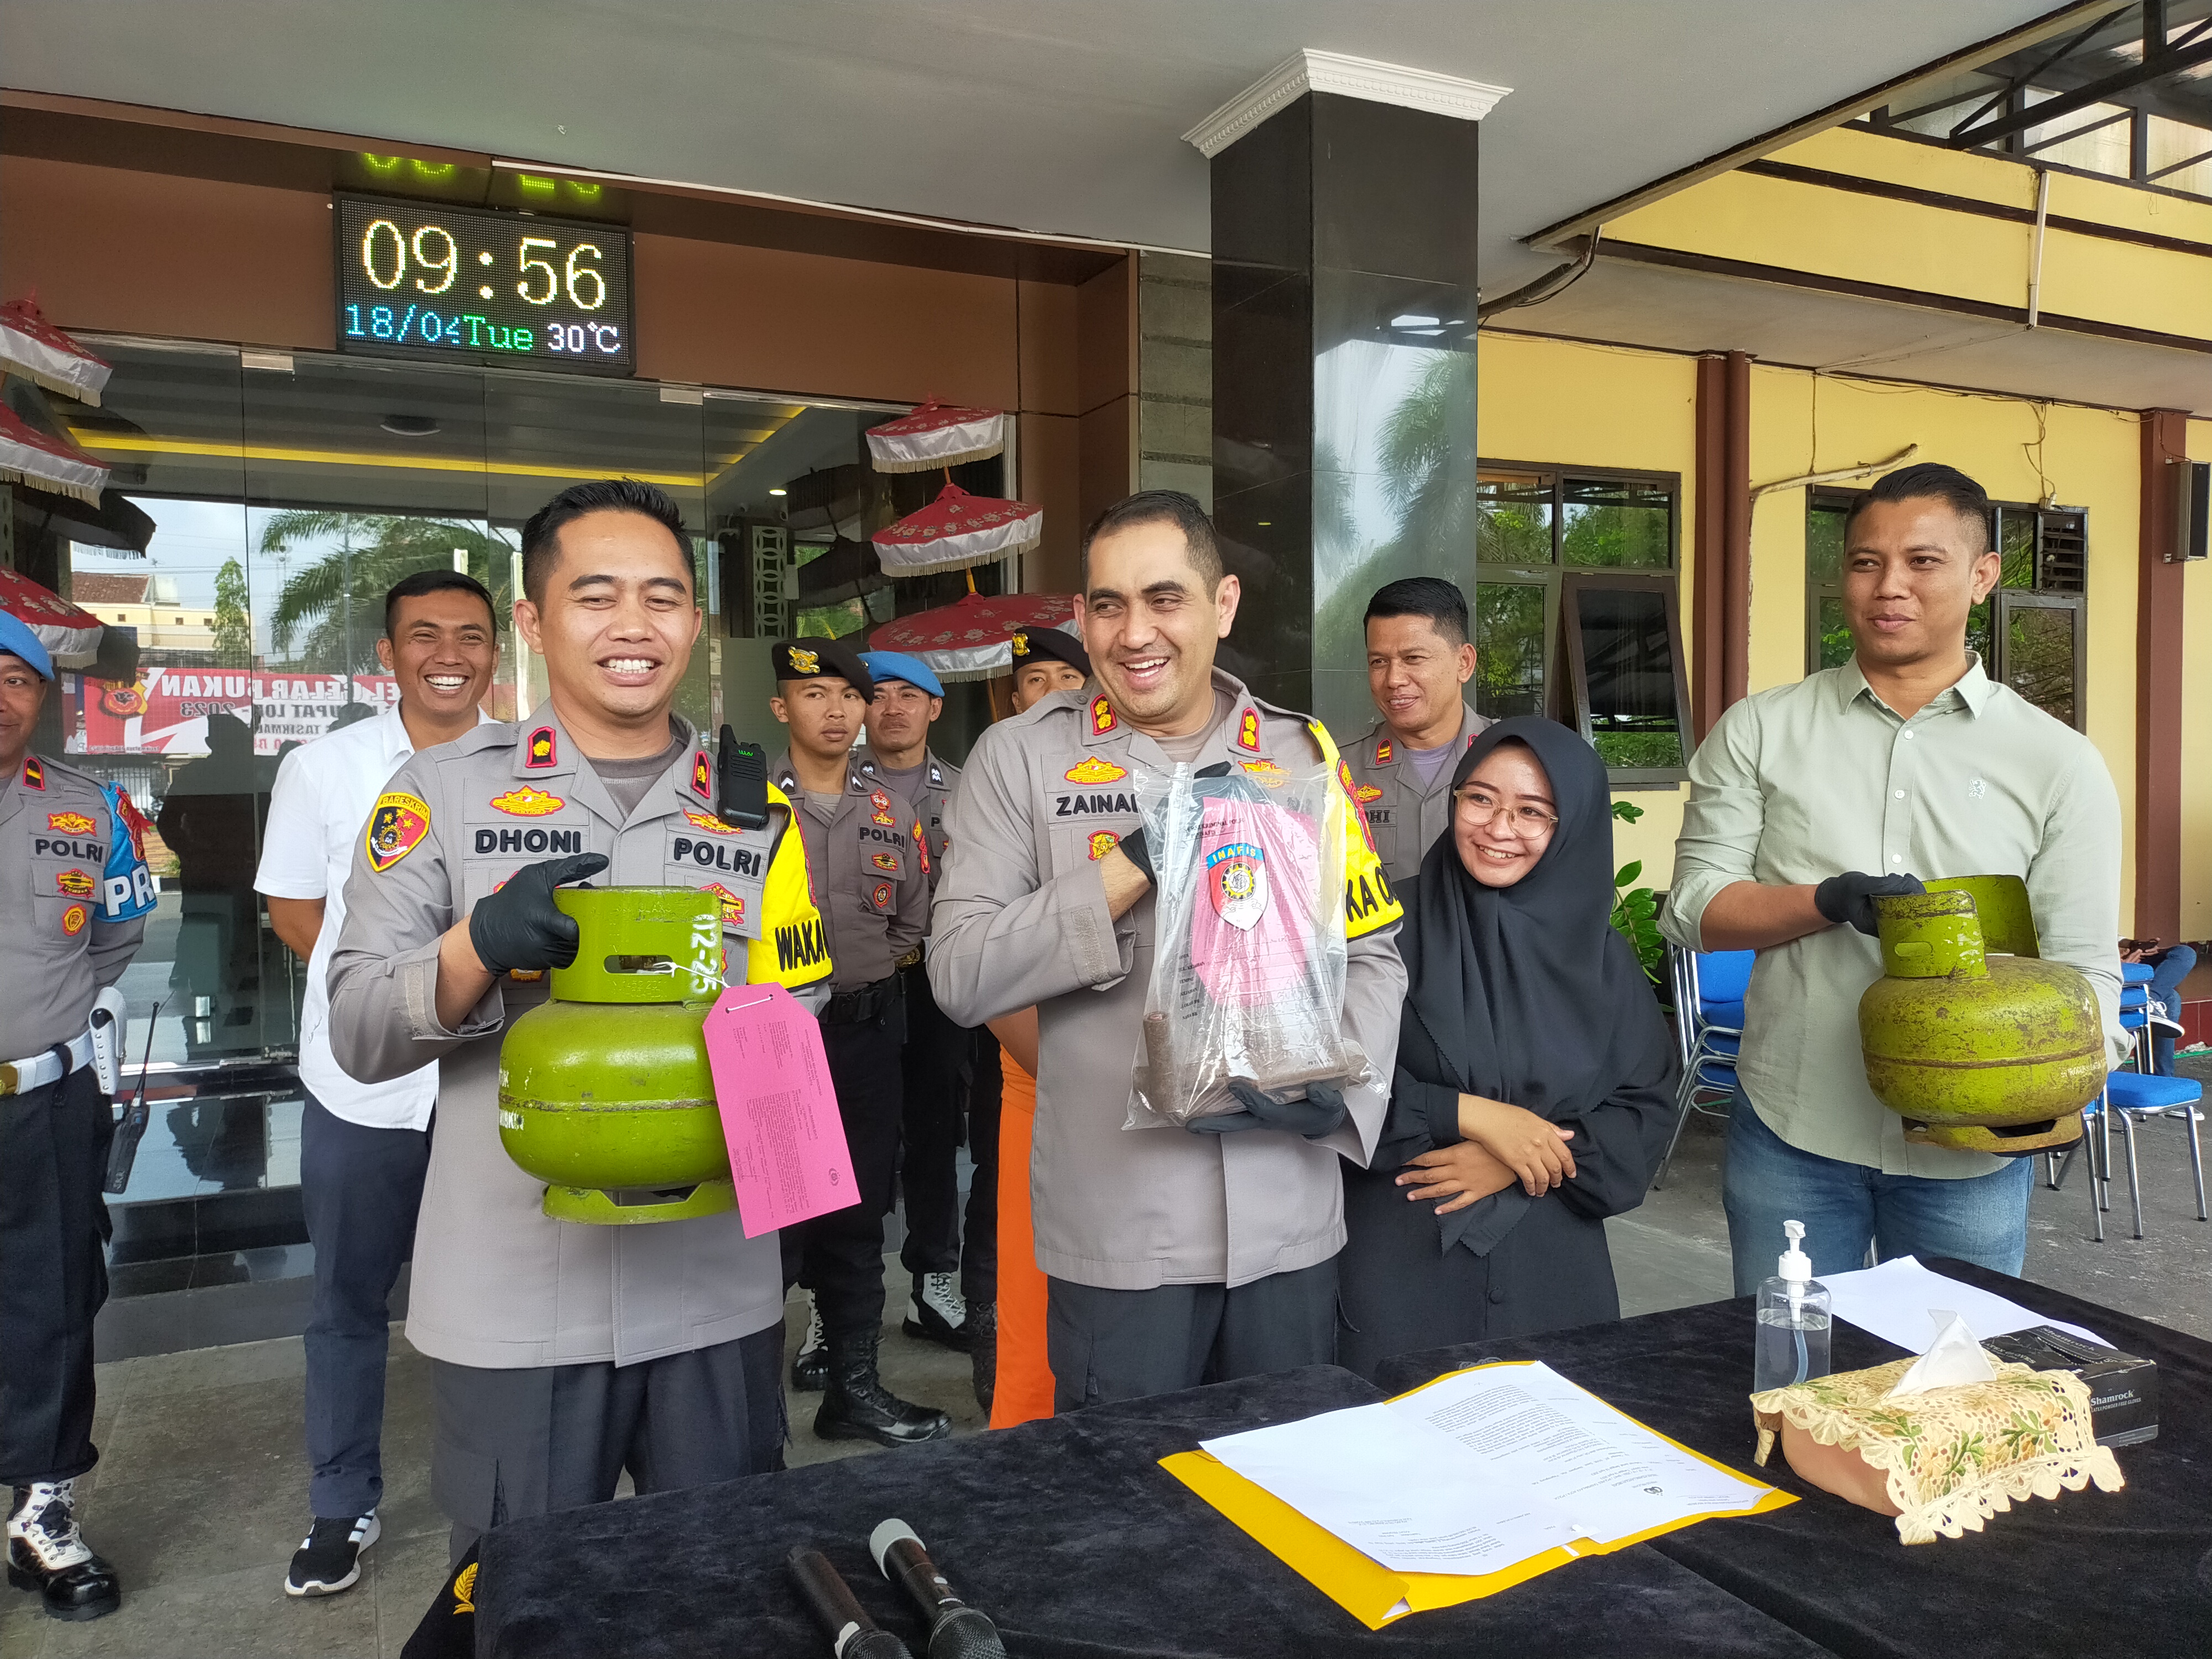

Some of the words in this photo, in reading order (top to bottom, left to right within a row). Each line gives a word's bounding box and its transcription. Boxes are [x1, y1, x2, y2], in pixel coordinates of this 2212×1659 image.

[363, 220, 605, 310] 09:56
[463, 315, 534, 351] Tue
[383, 796, 428, 817] BARESKRIM
[1366, 810, 1390, 823] HI
[476, 829, 581, 854] DHONI
[860, 827, 904, 848] POLRI
[35, 839, 103, 863] POLRI
[674, 838, 761, 877] POLRI
[1212, 846, 1256, 863] INAFIS
[775, 919, 831, 972] WAKA
[2090, 1390, 2134, 1406] Shamrock
